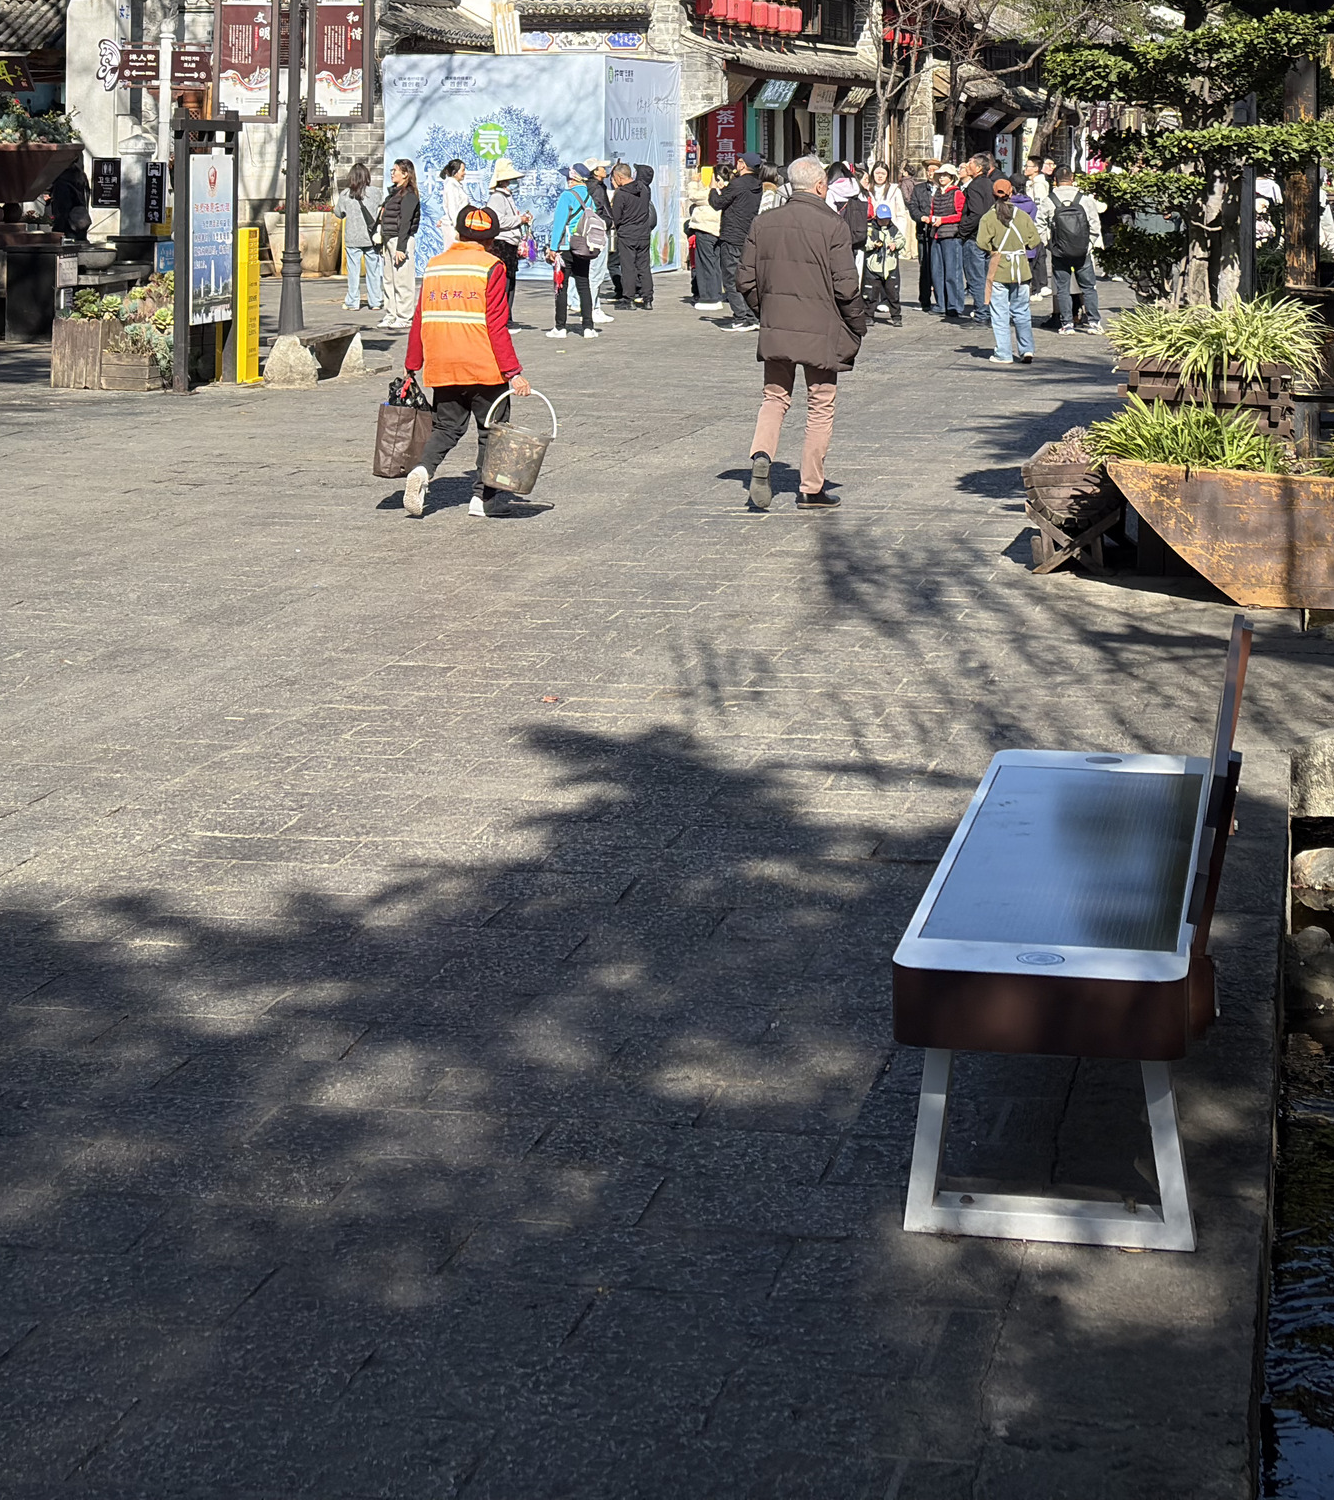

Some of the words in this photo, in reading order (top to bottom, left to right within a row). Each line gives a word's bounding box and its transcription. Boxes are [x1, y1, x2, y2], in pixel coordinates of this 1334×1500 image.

[254, 11, 270, 40] 文明
[346, 11, 362, 40] 和谐
[609, 117, 630, 141] 1000
[716, 110, 735, 166] 茶厂直销
[97, 176, 118, 184] 卫生间
[427, 290, 479, 302] 景区环卫
